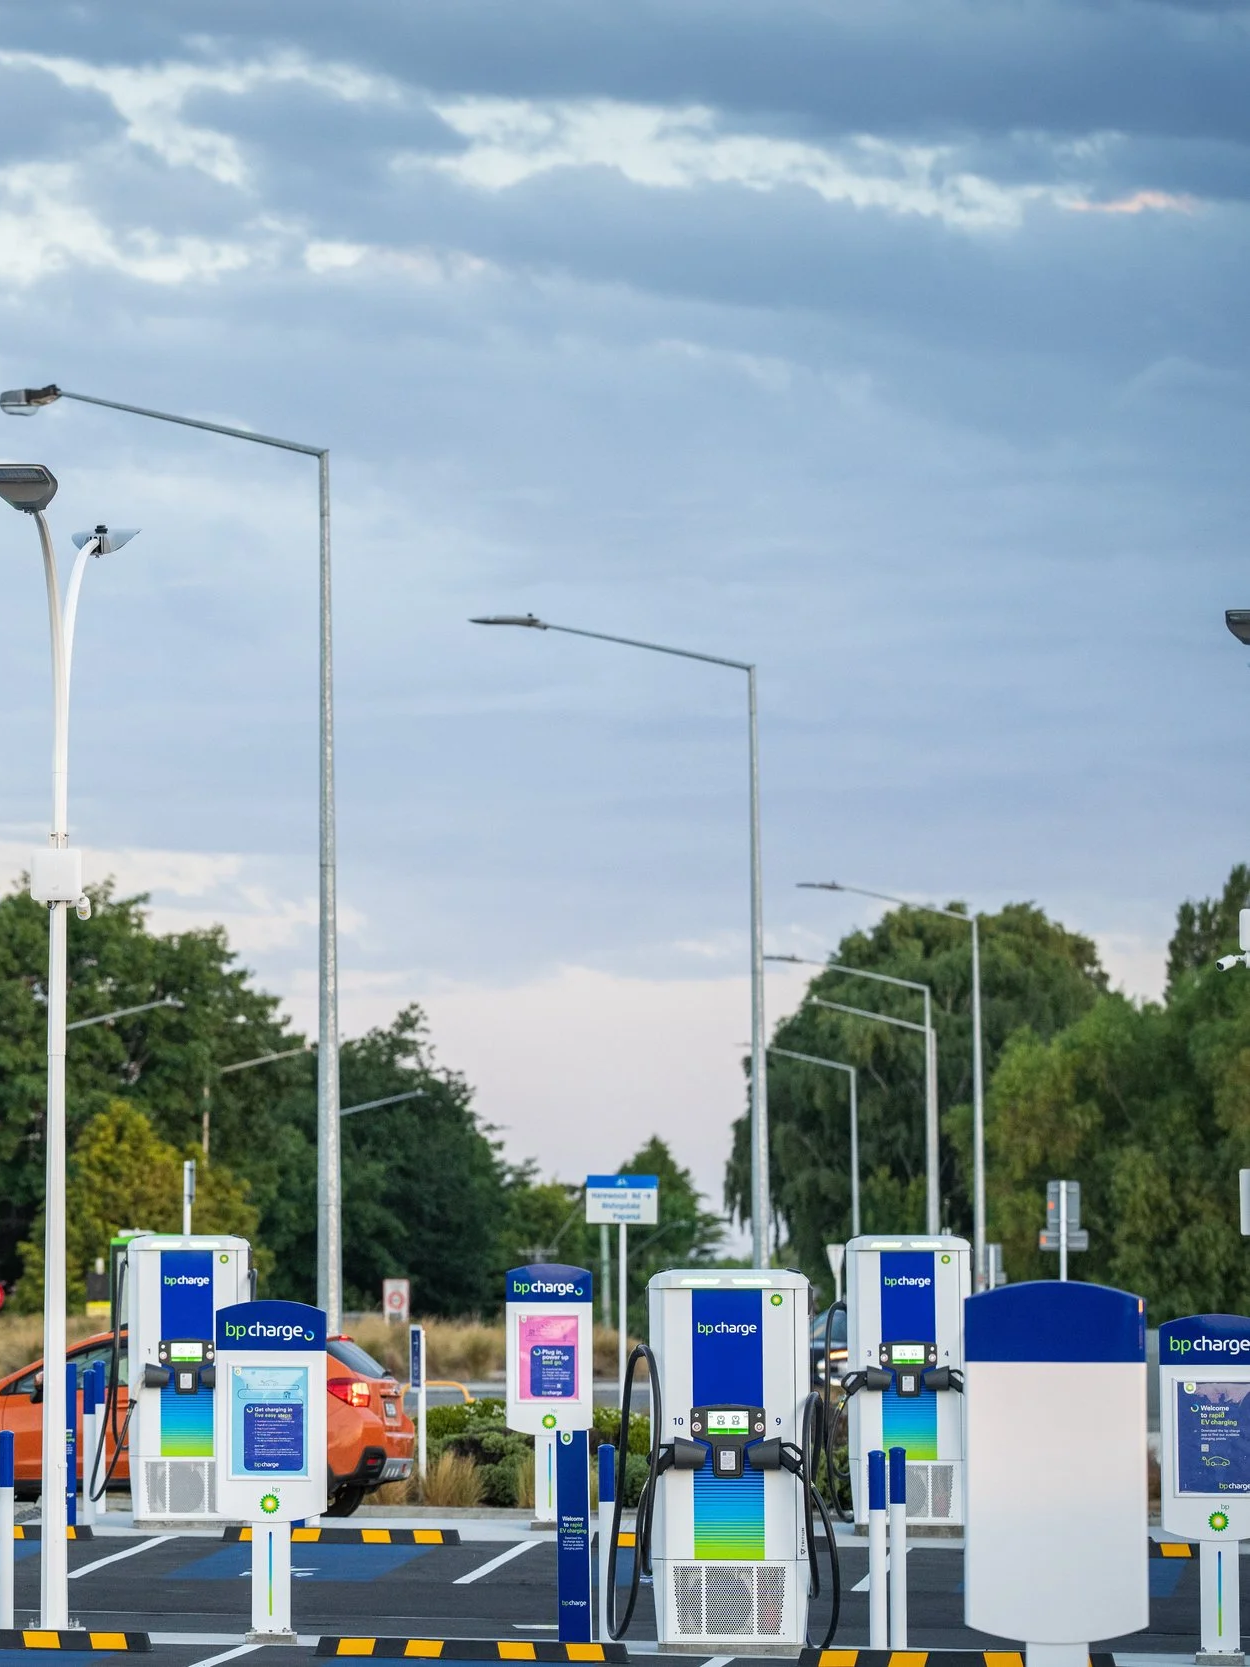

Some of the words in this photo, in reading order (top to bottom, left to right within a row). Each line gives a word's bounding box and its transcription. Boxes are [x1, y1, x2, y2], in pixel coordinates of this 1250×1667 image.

[226, 1322, 246, 1340] bp
[248, 1322, 303, 1340] charge
[1170, 1336, 1191, 1355] bp
[1193, 1336, 1250, 1355] charge
